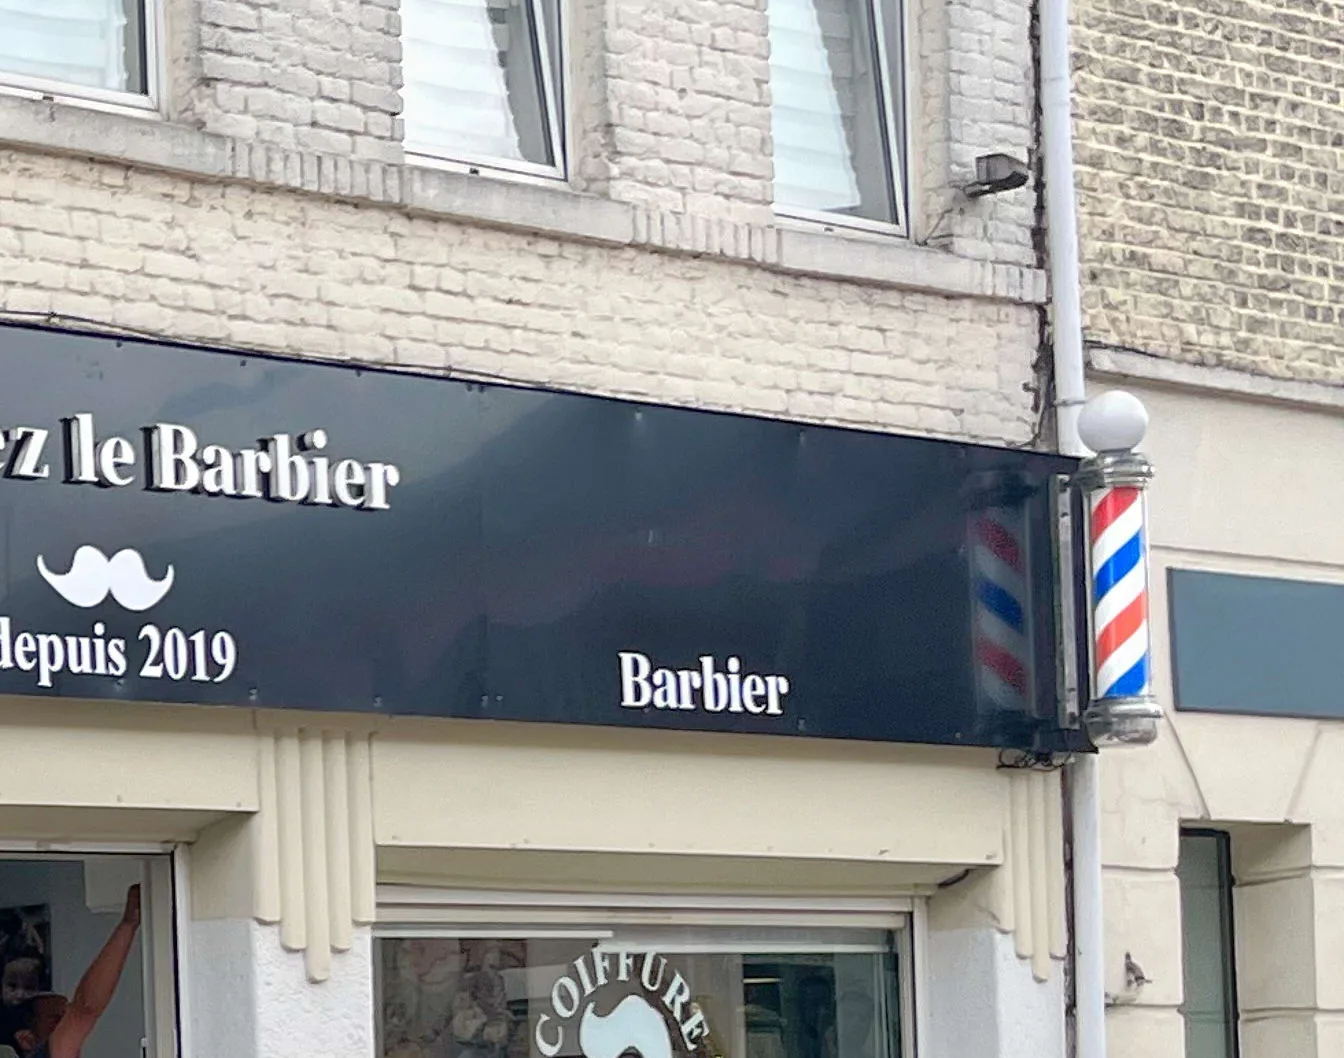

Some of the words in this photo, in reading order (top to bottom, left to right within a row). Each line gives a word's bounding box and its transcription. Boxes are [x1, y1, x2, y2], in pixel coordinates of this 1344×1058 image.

[62, 413, 136, 486] le
[145, 422, 400, 511] Barbier
[138, 624, 236, 683] 2019
[617, 651, 790, 715] Barbier
[535, 949, 710, 1058] COIFFURE
